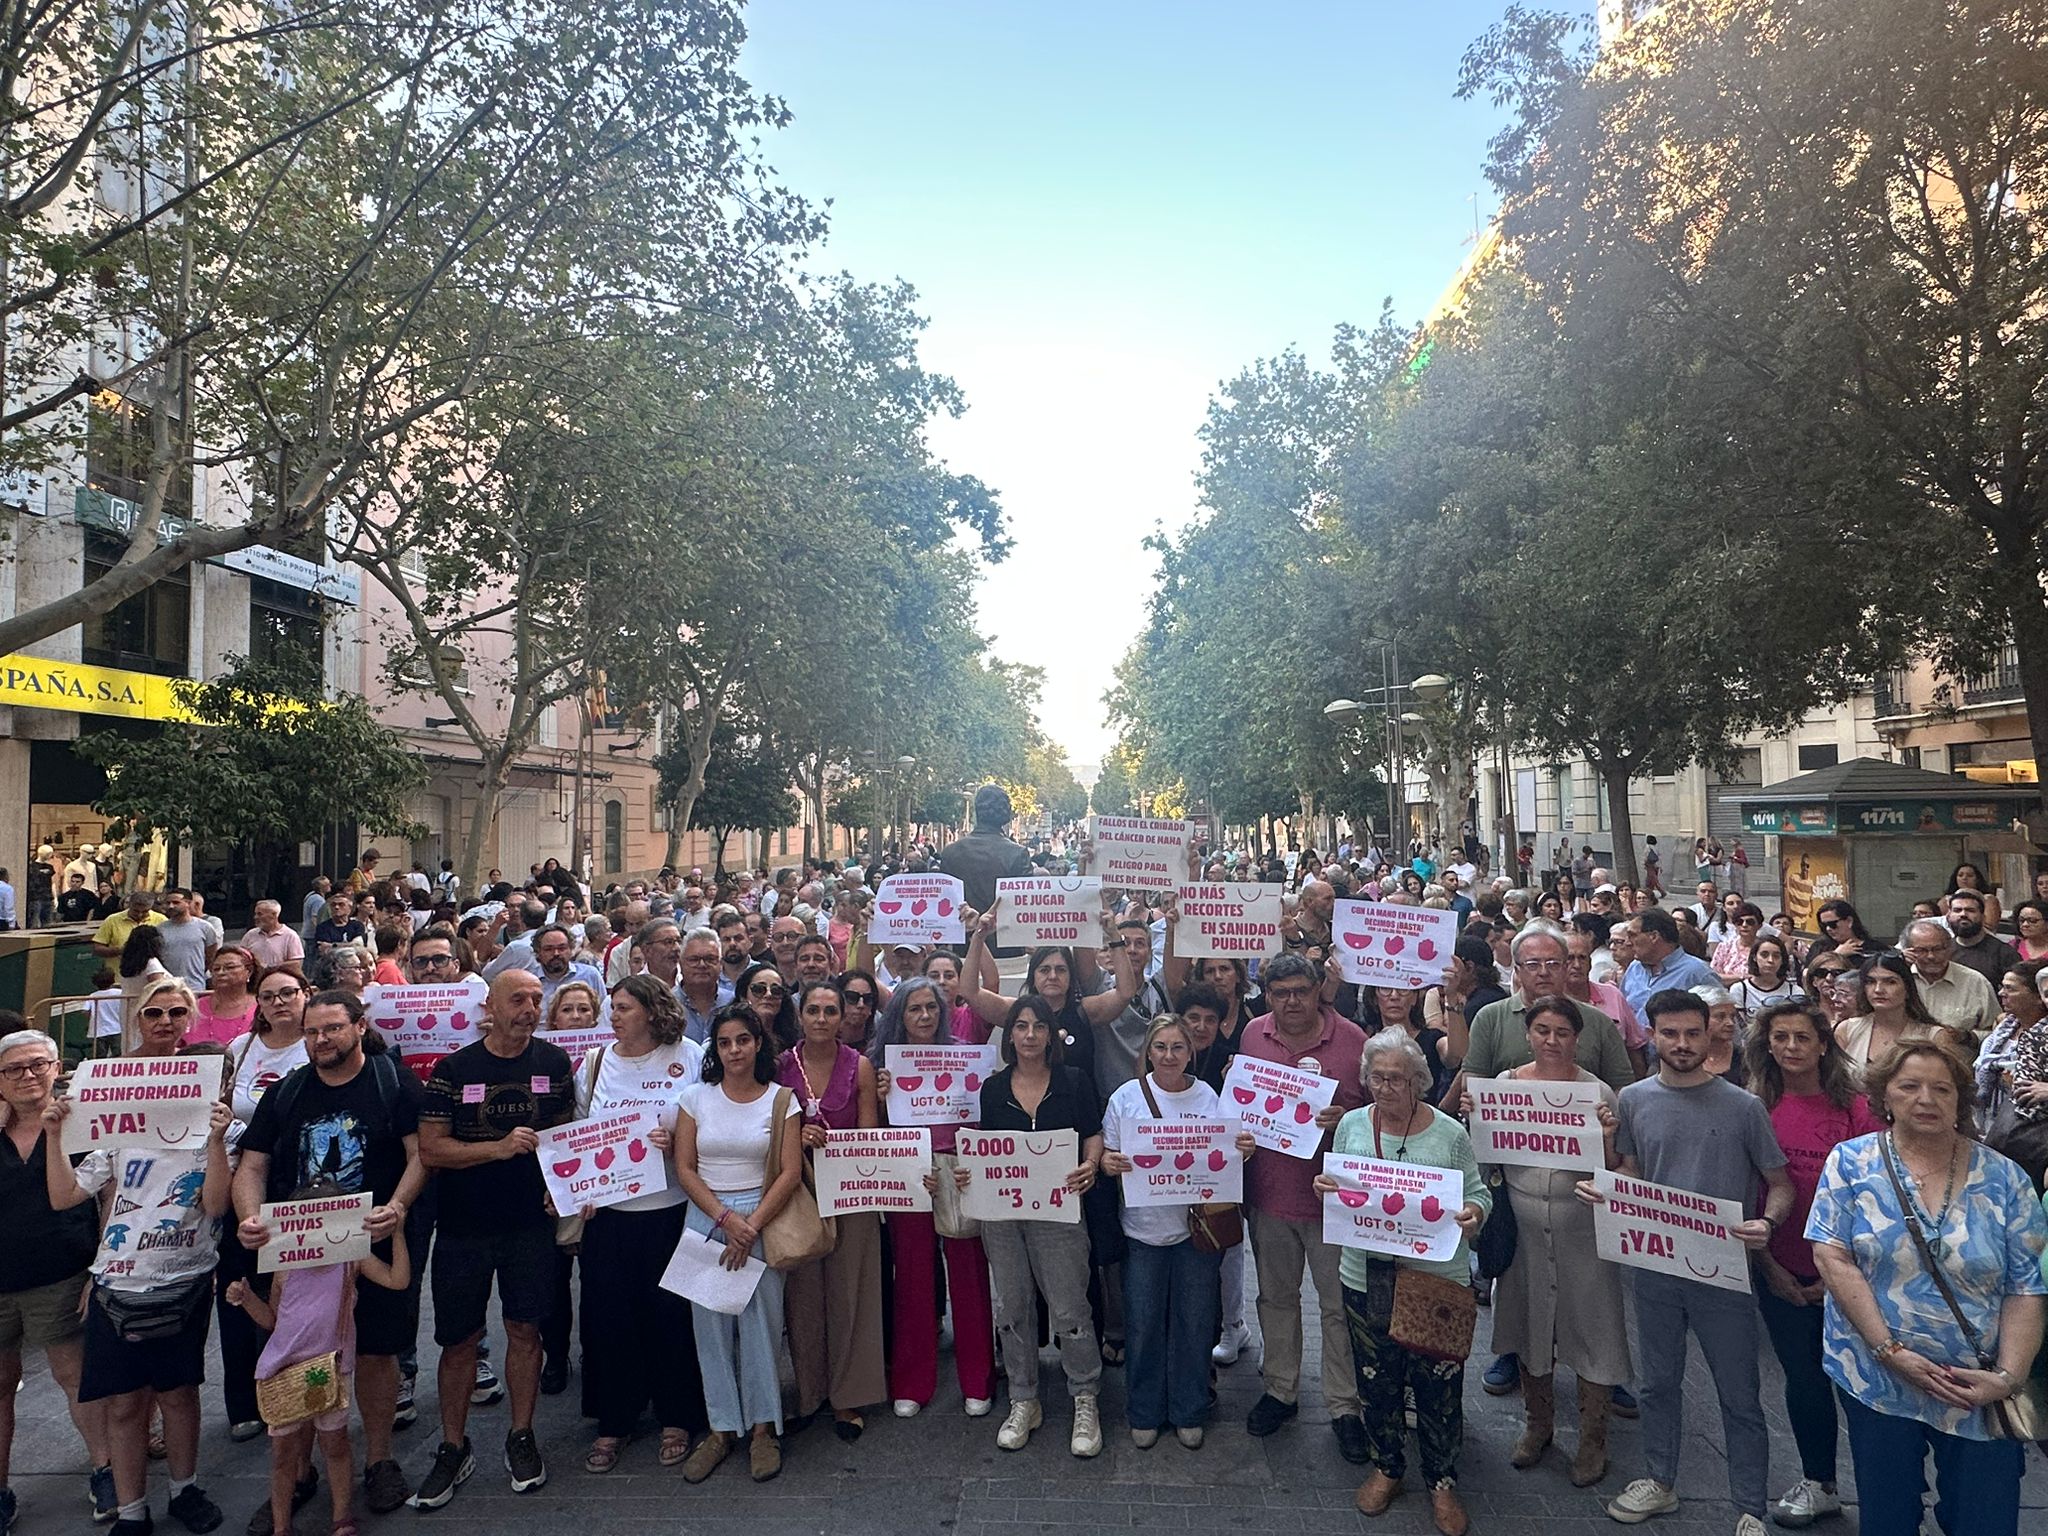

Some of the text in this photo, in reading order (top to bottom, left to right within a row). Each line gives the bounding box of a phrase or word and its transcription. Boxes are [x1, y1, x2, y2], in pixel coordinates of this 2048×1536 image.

[1098, 818, 1186, 832] FALLOS EN EL CRIBADO
[1752, 813, 1775, 825] 11/11
[1861, 811, 1904, 825] 11/11
[1099, 831, 1182, 846] DEL CÁNCER DE MAMA
[1109, 860, 1168, 872] PELIGRO PARA
[1000, 880, 1051, 891] BASTA YA
[1102, 874, 1172, 887] MILES DE MUJERES
[1179, 884, 1225, 900] NO MÁS
[1014, 895, 1065, 906] DE JUGAR
[1016, 911, 1087, 923] CON NUESTRA
[1184, 903, 1244, 917] RECORTES
[1351, 906, 1365, 915] CON
[1367, 908, 1375, 916] LA
[1398, 911, 1407, 920] EN
[1408, 912, 1415, 921] EL
[889, 919, 910, 928] UGT
[1201, 922, 1276, 936] EN SANIDAD
[1036, 927, 1078, 939] SALUD
[1212, 937, 1266, 951] PUBLICA
[1357, 956, 1382, 968] UGT
[394, 1033, 419, 1041] UGT
[91, 1061, 199, 1078] NI UNA MUJER
[642, 1081, 664, 1089] UGT
[80, 1084, 201, 1103] DESINFORMADA
[1480, 1092, 1533, 1106] LA VIDA
[486, 1102, 533, 1114] GUESS
[603, 1100, 617, 1109] Lo
[911, 1097, 934, 1107] UGT
[1241, 1111, 1261, 1125] UGT
[1481, 1108, 1585, 1127] DE LAS MUJERES
[90, 1113, 146, 1141] ¡YA!
[552, 1133, 568, 1143] CON
[568, 1129, 577, 1139] LA
[600, 1121, 610, 1130] EN
[610, 1118, 618, 1128] EL
[1153, 1125, 1161, 1134] LA
[857, 1131, 868, 1141] EN
[870, 1131, 879, 1141] EL
[881, 1131, 921, 1141] CRIBADO
[961, 1137, 1015, 1157] 2.000
[1492, 1131, 1581, 1156] IMPORTA
[825, 1146, 919, 1158] DEL CÁNCER DE MAMA
[124, 1158, 157, 1189] 91
[985, 1166, 1029, 1179] NO SON
[1343, 1160, 1443, 1181] CON LA MANO EN EL PECHO
[570, 1177, 596, 1193] UGT
[840, 1180, 906, 1191] PELIGRO PARA
[1149, 1174, 1173, 1185] UGT
[834, 1196, 914, 1209] MILES DE MUJERES
[1614, 1178, 1717, 1216] NI UNA MUJER
[272, 1197, 361, 1218] NOS QUEREMOS
[1032, 1200, 1040, 1210] o
[280, 1217, 323, 1233] VIVAS
[1353, 1215, 1382, 1229] UGT
[1610, 1200, 1727, 1240] DESINFORMADA
[296, 1234, 305, 1246] Y
[1620, 1229, 1674, 1260] ¡YA!
[279, 1247, 324, 1264] SANAS
